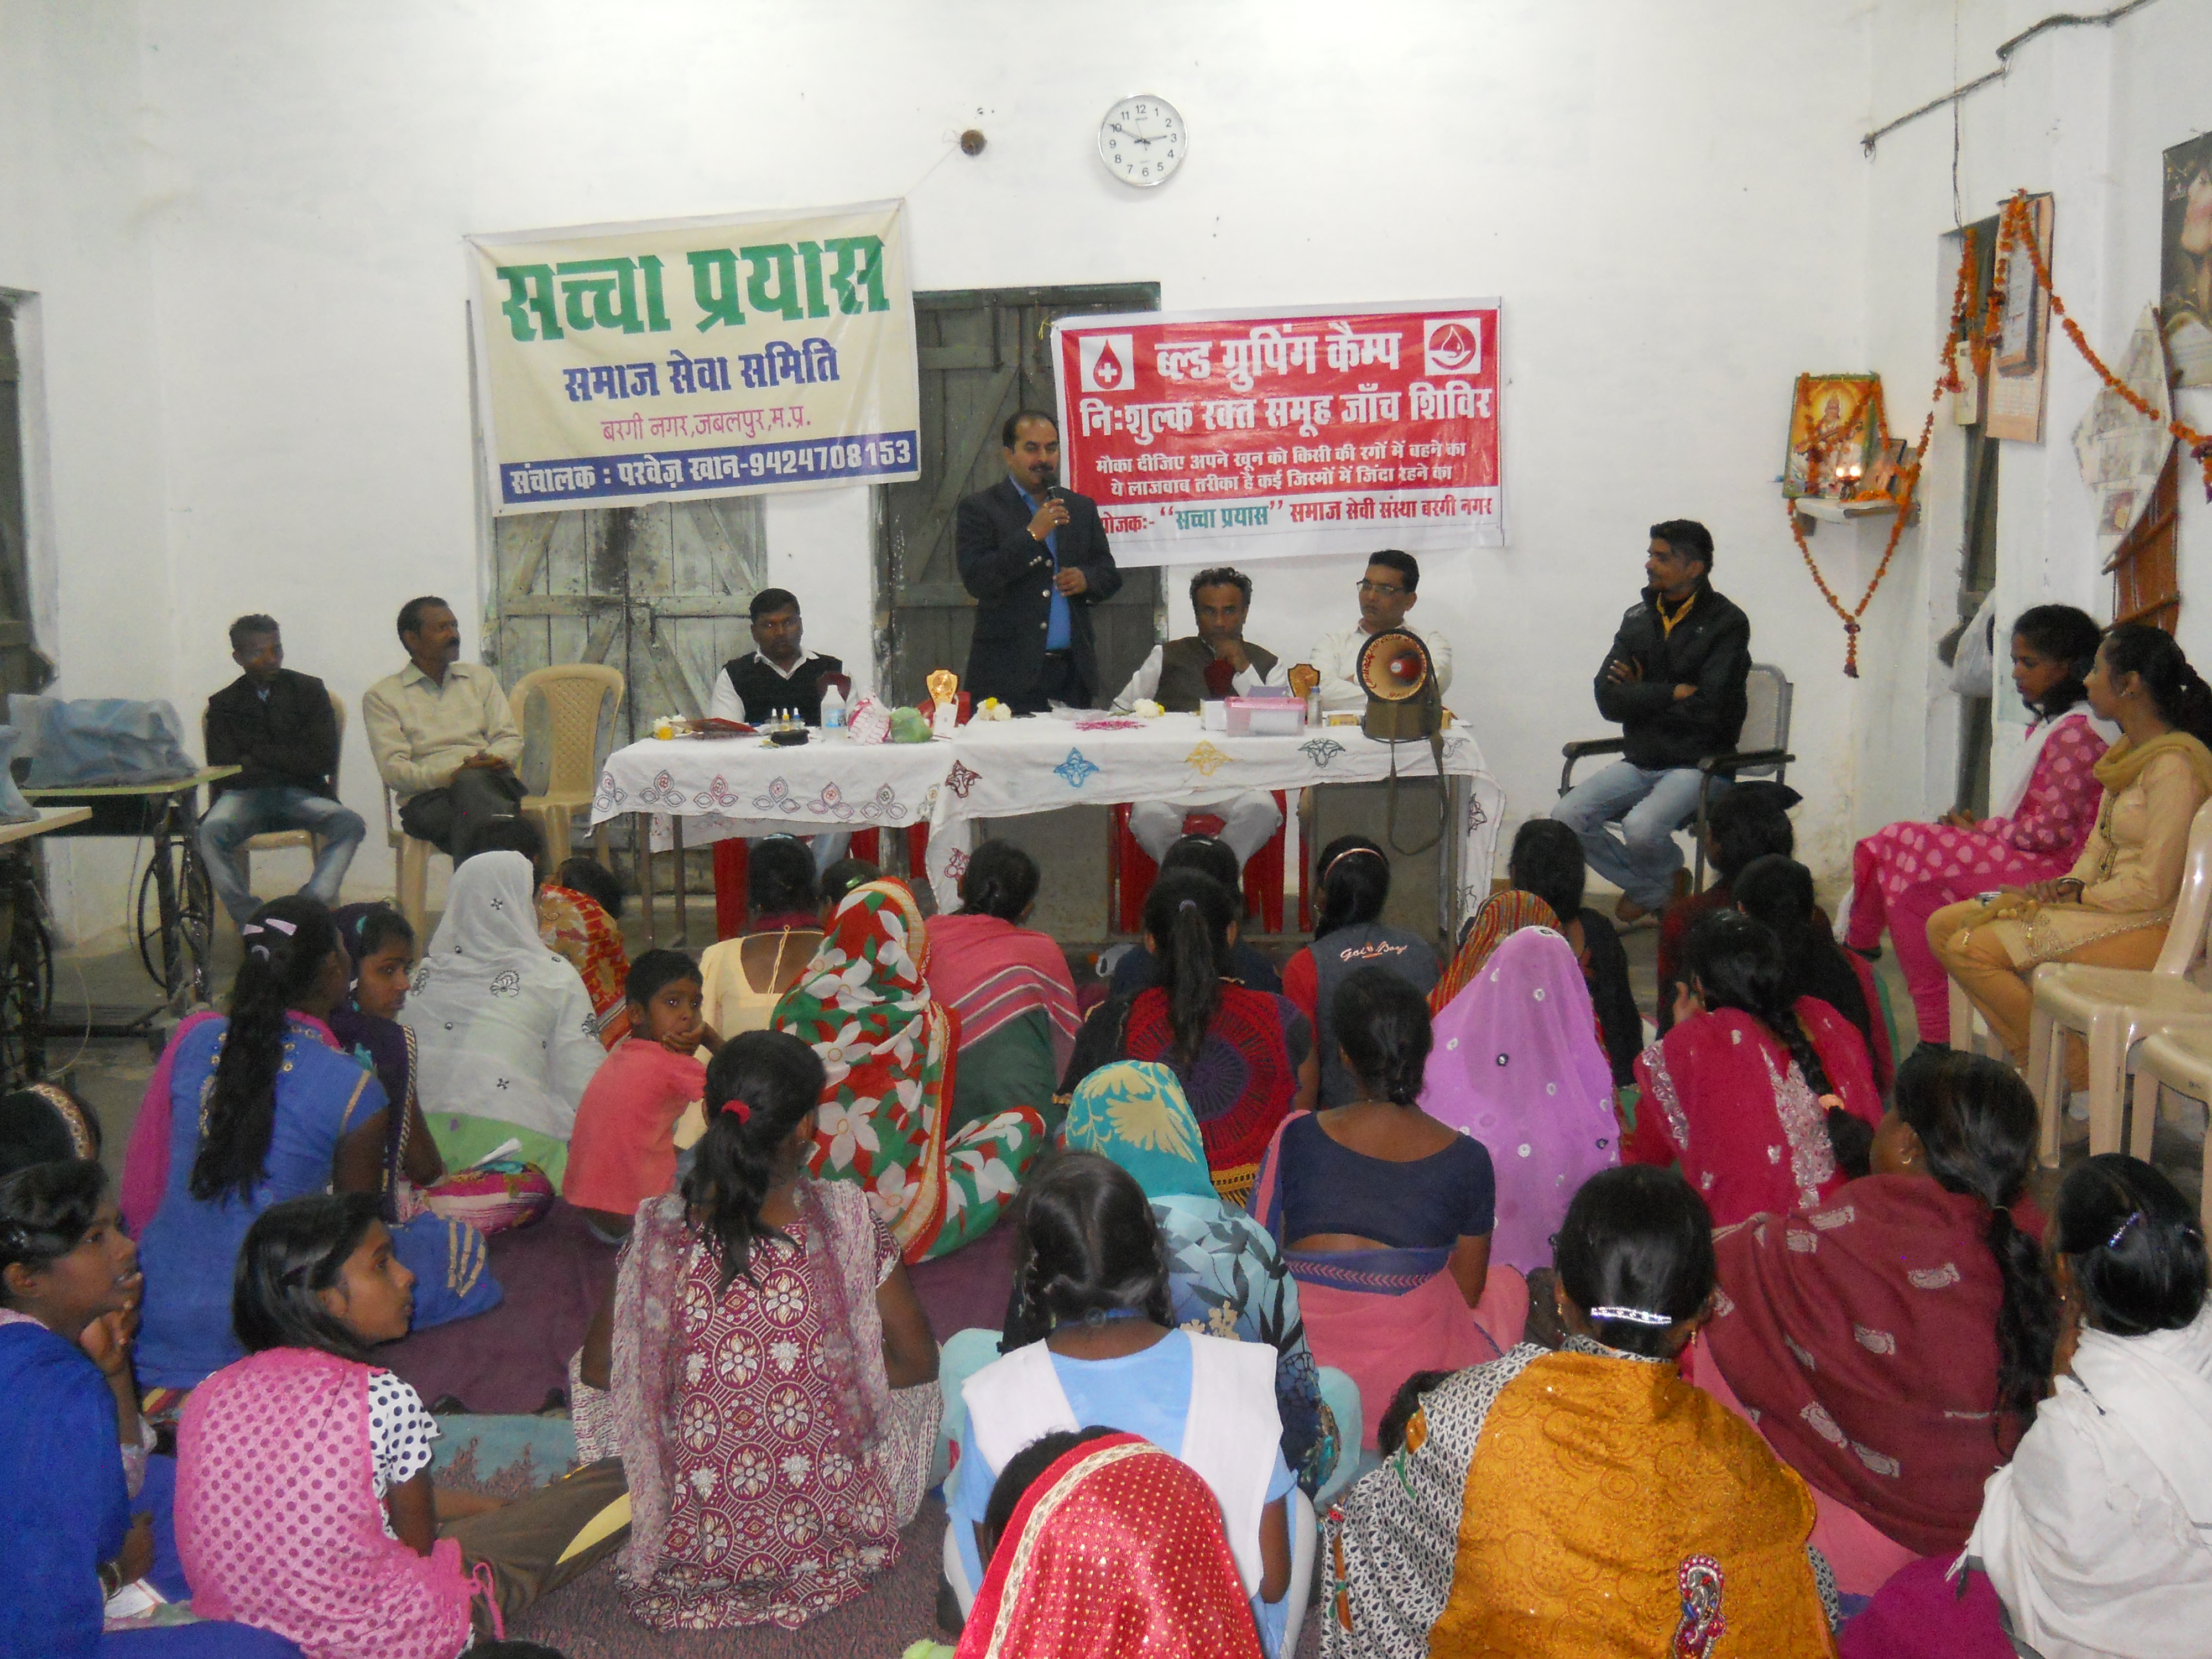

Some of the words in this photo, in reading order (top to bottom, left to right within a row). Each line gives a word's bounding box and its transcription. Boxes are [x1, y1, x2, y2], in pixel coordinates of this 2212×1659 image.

[1136, 105, 1146, 114] 12
[1155, 108, 1159, 117] 1
[1121, 111, 1130, 120] 11
[1166, 118, 1172, 127] 2
[1112, 123, 1122, 133] 10
[1171, 133, 1177, 143] 3
[1109, 139, 1116, 148] 9
[1115, 154, 1121, 163] 8
[1167, 149, 1174, 158] 4
[1127, 164, 1133, 174] 7
[1157, 162, 1164, 171] 5
[1142, 168, 1149, 176] 6
[496, 254, 671, 342] सच्चा
[686, 234, 890, 333] प्रयास
[1220, 324, 1318, 392] ग्रुपिंग
[1325, 321, 1402, 373] कैम्प
[563, 362, 660, 402] समाज
[667, 349, 731, 394] सेवा
[738, 337, 840, 388] समिति
[1201, 399, 1256, 430] रक्त
[1264, 395, 1334, 437] समूह
[1409, 380, 1493, 420] शिविर
[601, 413, 643, 441] बरगी
[1096, 456, 1133, 473] मौका
[1137, 453, 1185, 472] दीजिए
[1190, 450, 1229, 469] अपने
[1234, 451, 1264, 472] खून
[1267, 447, 1288, 465] को
[1293, 445, 1332, 463] किसी
[1335, 443, 1357, 461] की
[1360, 441, 1387, 460] रगों
[1391, 440, 1406, 458] में
[1445, 442, 1467, 457] का
[510, 463, 596, 494] संचालक
[618, 455, 684, 488] परवेज़
[688, 440, 911, 481] खान-9424708153
[1110, 478, 1124, 496] ये
[1127, 478, 1190, 496] लाजवाब
[1194, 473, 1240, 492] तरीका
[1240, 472, 1254, 489] है
[1257, 469, 1283, 489] कई
[1287, 466, 1335, 487] जिस्मों
[1339, 466, 1354, 484] में
[1356, 464, 1395, 483] जिंदा
[1397, 463, 1428, 482] रहने
[1432, 466, 1453, 480] का
[1290, 500, 1342, 523] समाज
[1346, 497, 1375, 520] सेवी
[1380, 495, 1417, 519] संस्था
[1421, 494, 1456, 517] बरगी
[1460, 498, 1493, 515] नगर
